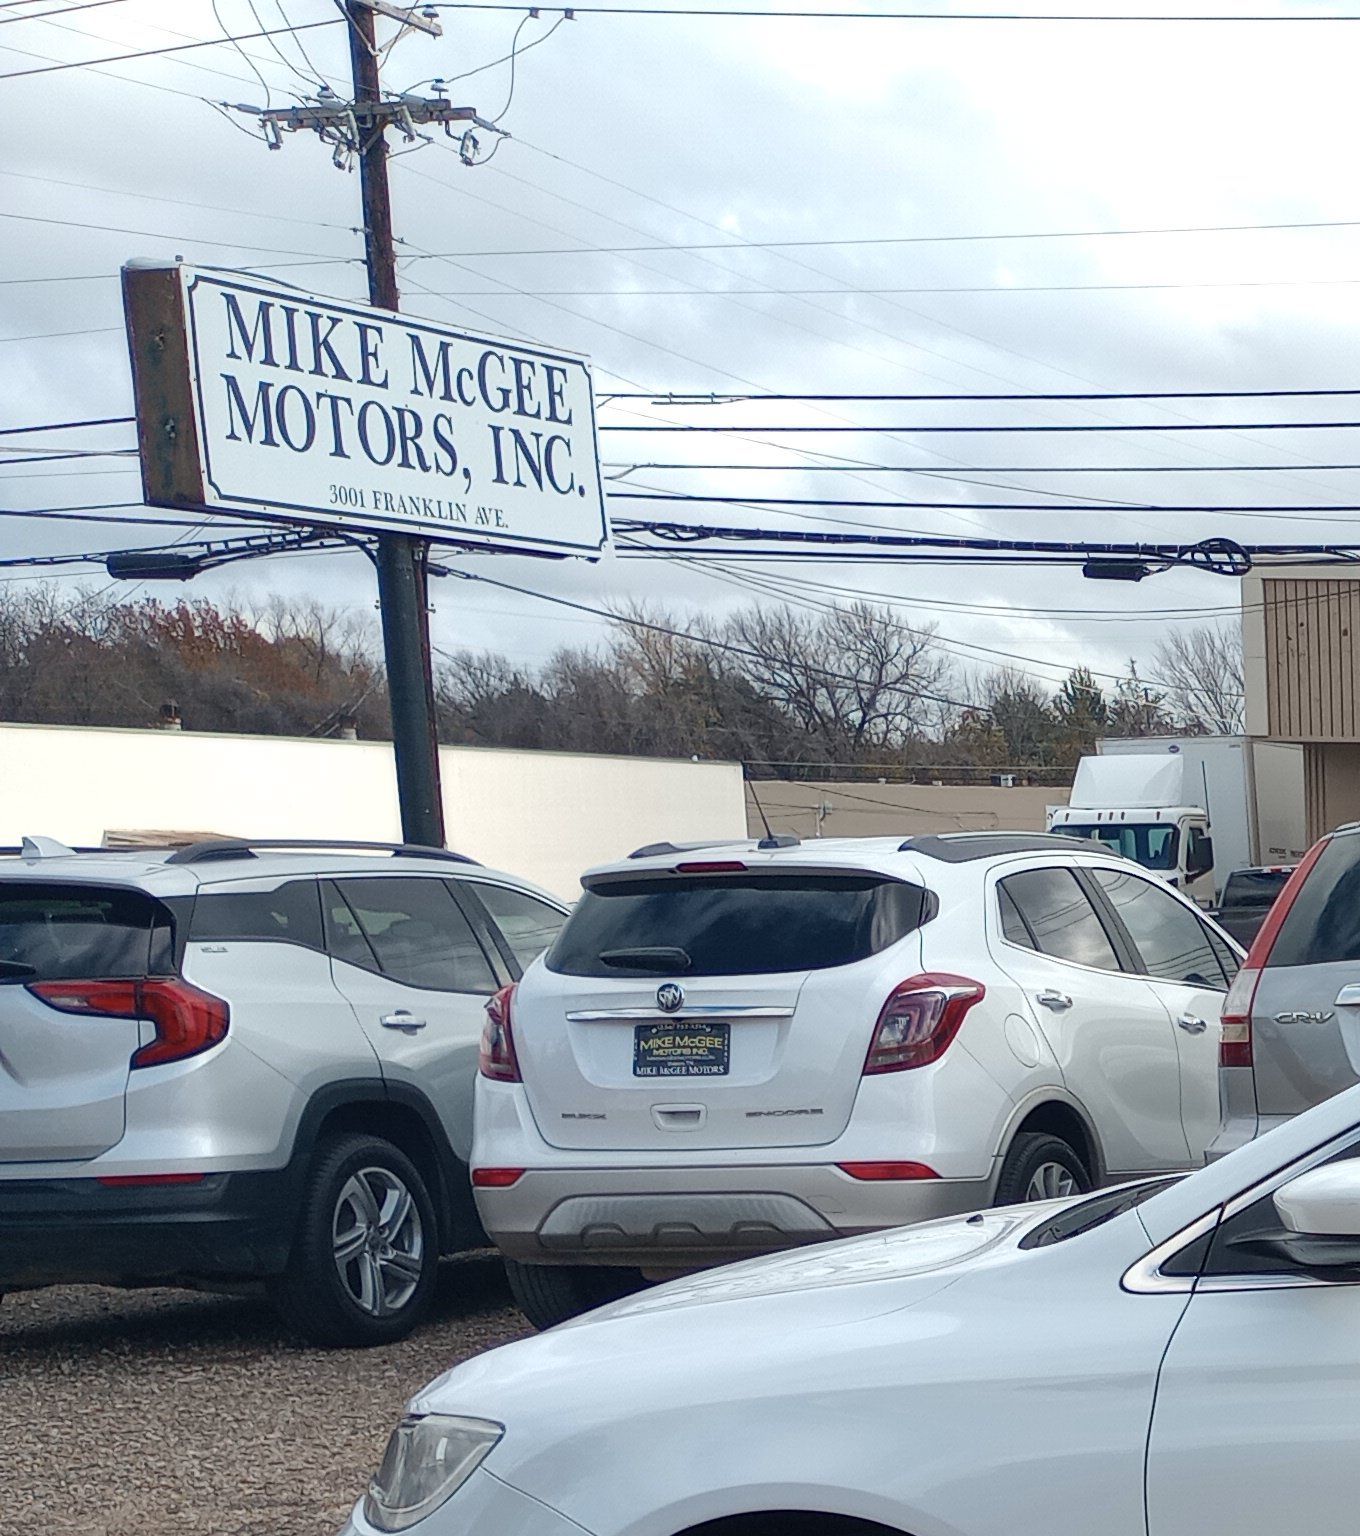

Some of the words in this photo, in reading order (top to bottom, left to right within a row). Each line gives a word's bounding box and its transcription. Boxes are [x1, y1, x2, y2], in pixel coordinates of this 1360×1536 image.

[220, 292, 390, 390] MIKE
[406, 332, 574, 426] McGEE
[219, 372, 473, 495] MOTORS,
[487, 424, 587, 498] INC.
[328, 484, 368, 509] 3001
[372, 489, 469, 524] FRANKLIN
[474, 506, 510, 530] AVE.
[1272, 1011, 1335, 1025] CR-V
[640, 1036, 674, 1053] MIKE
[675, 1035, 724, 1049] McGEE
[688, 1064, 724, 1074] MOTORS
